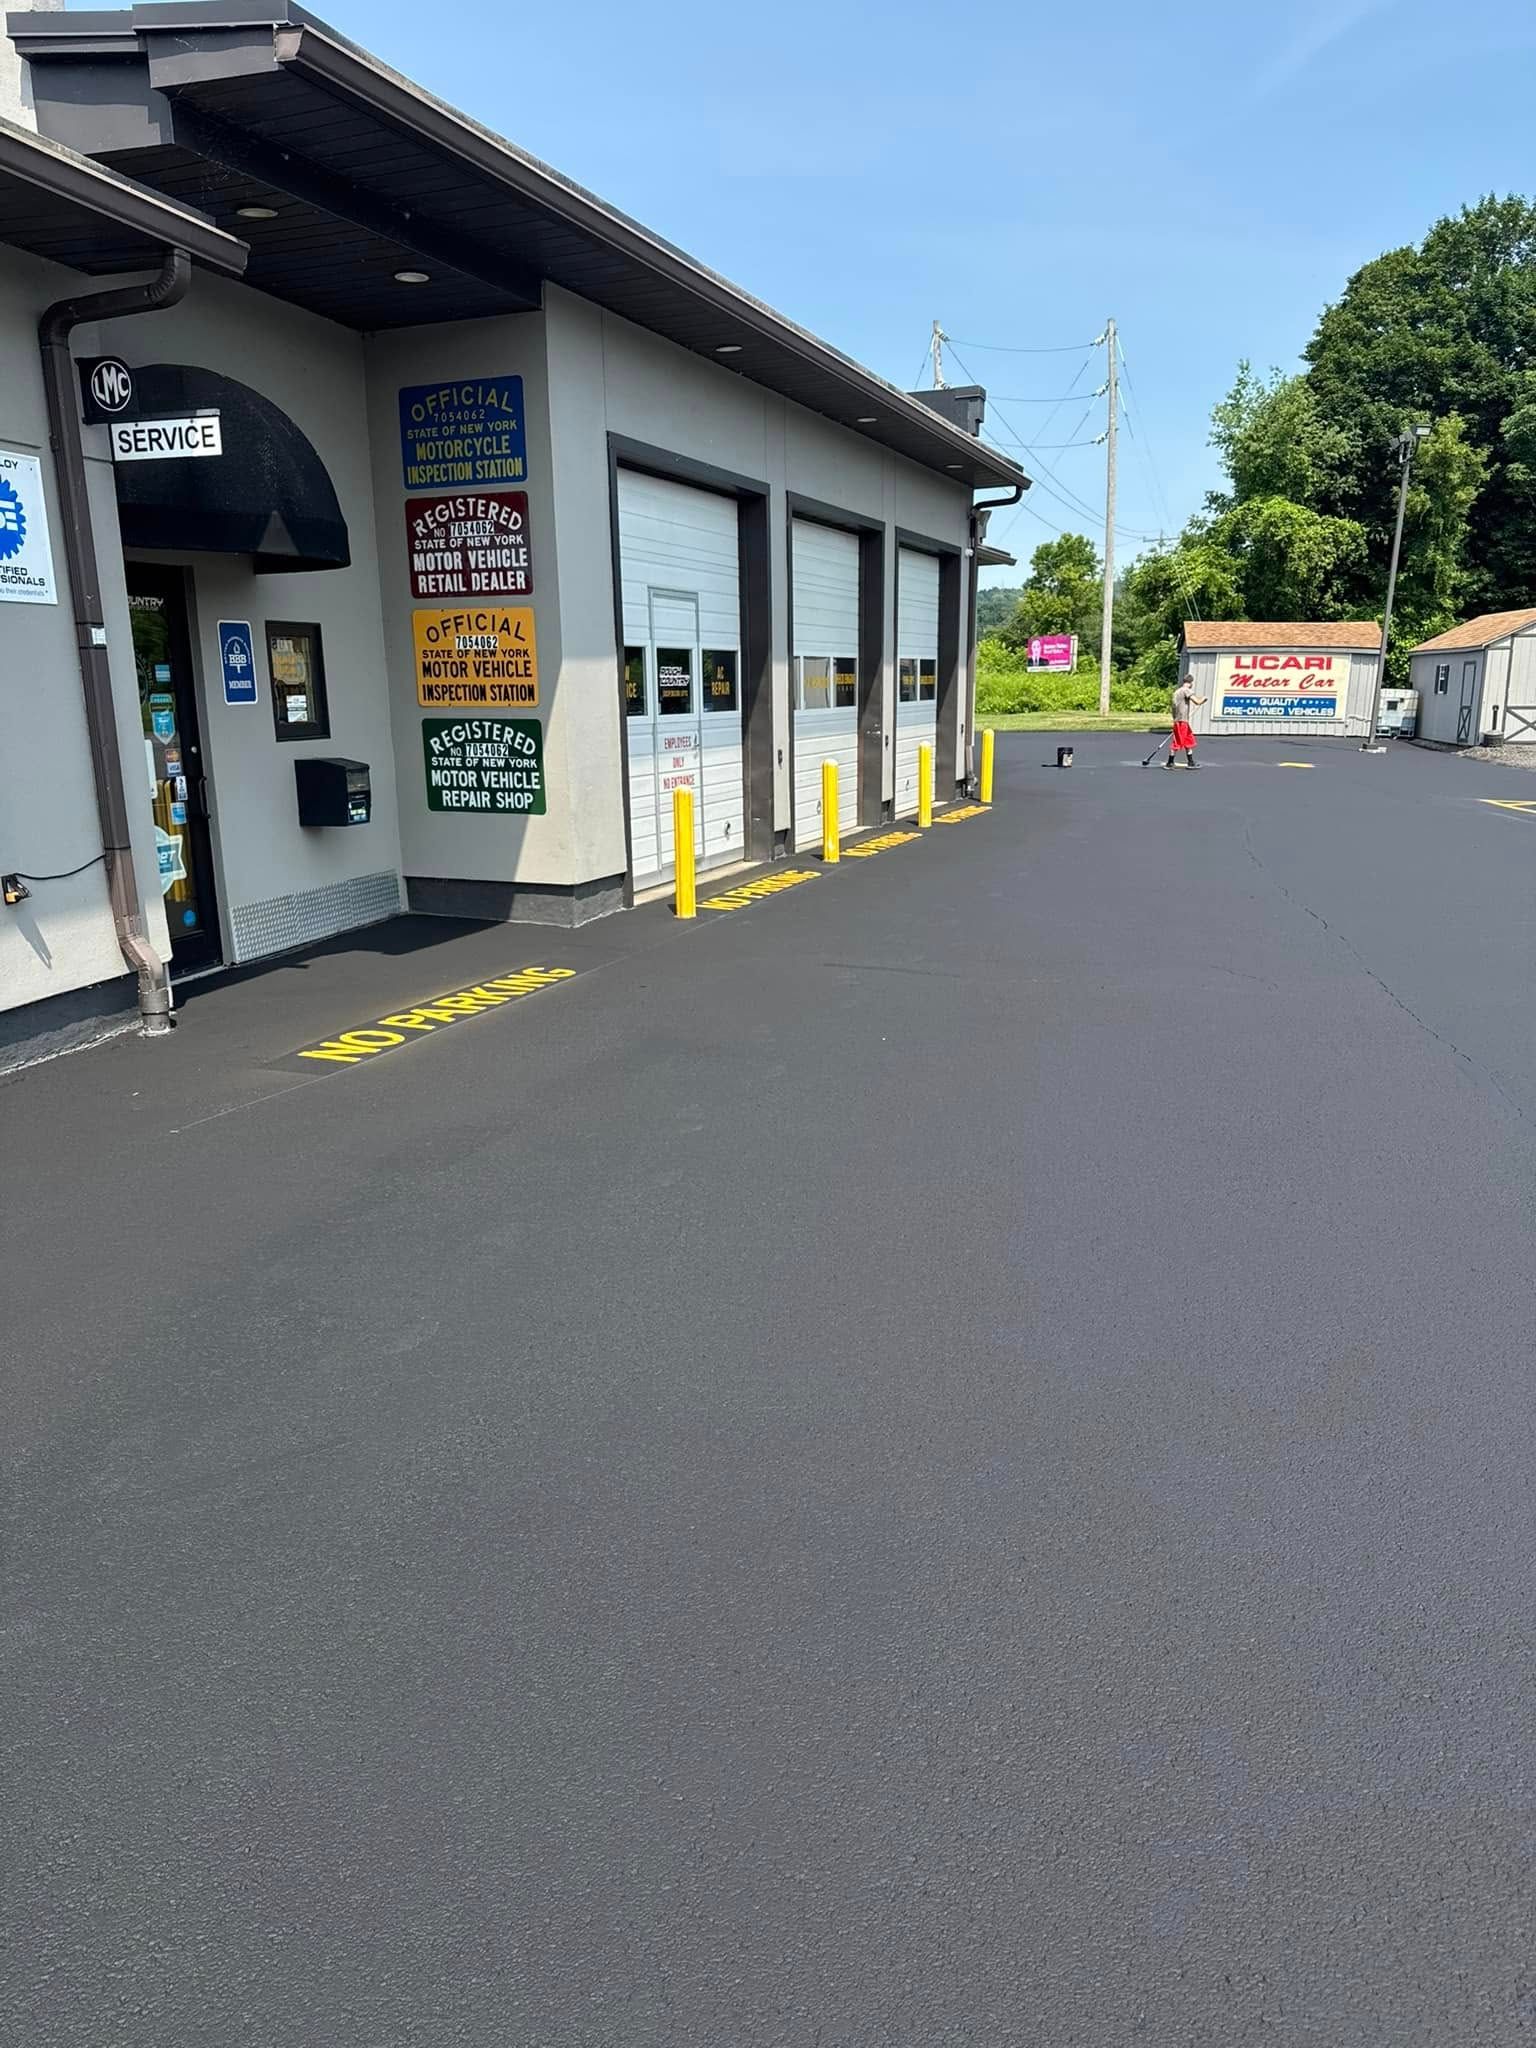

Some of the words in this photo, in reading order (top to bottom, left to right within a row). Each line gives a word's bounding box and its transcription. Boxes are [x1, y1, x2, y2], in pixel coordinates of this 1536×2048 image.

[95, 366, 129, 405] LMC
[411, 385, 513, 422] OFFICIAL
[434, 408, 486, 422] 7054062
[407, 427, 438, 439] STATE
[442, 425, 456, 436] OF
[460, 422, 483, 434] NEW
[488, 419, 517, 431] YORK
[117, 425, 216, 453] SERVICE
[416, 435, 511, 461] MOTORCYCLE
[407, 461, 472, 485] INSPECTION
[476, 457, 523, 480] STATION
[413, 498, 522, 537] REGISTERED
[451, 520, 494, 536] 7054062
[414, 538, 446, 550] STATE
[450, 536, 463, 548] OF
[467, 536, 490, 548] NEW
[494, 534, 524, 546] YORK
[413, 552, 463, 572] MOTOR
[468, 548, 528, 569] VEHICLE
[418, 573, 467, 593] RETAIL
[472, 570, 526, 591] DEALER
[426, 613, 526, 643] OFFICIAL
[456, 635, 498, 649] 7054062
[228, 654, 247, 664] BBB
[422, 649, 453, 659] STATE
[457, 649, 470, 659] OF
[474, 649, 497, 658] NEW
[501, 649, 530, 659] YORK
[1235, 655, 1333, 670] LICARI
[422, 661, 468, 678] MOTOR
[473, 660, 532, 678] VEHICLE
[1230, 673, 1290, 688] Motor
[1299, 673, 1334, 689] Car
[423, 684, 486, 701] INSPECTION
[490, 684, 535, 701] STATION
[1223, 706, 1284, 715] PRE-OWNED
[1288, 707, 1334, 716] VEHICLES
[1260, 697, 1300, 707] QUALITY
[430, 721, 536, 756] REGISTERED
[664, 736, 691, 750] EMPLOYEES
[466, 743, 509, 757] 7054062
[431, 757, 462, 767] STATE
[465, 758, 478, 767] OF
[483, 757, 506, 767] NEW
[508, 758, 537, 768] YORK
[431, 769, 478, 788] MOTOR
[481, 771, 541, 789] VEHICLE
[442, 790, 491, 808] REPAIR
[496, 792, 534, 809] SHOP
[695, 896, 752, 911] NO
[725, 869, 822, 899] PARKING
[297, 1030, 405, 1063] NO
[376, 967, 577, 1030] PARKING
